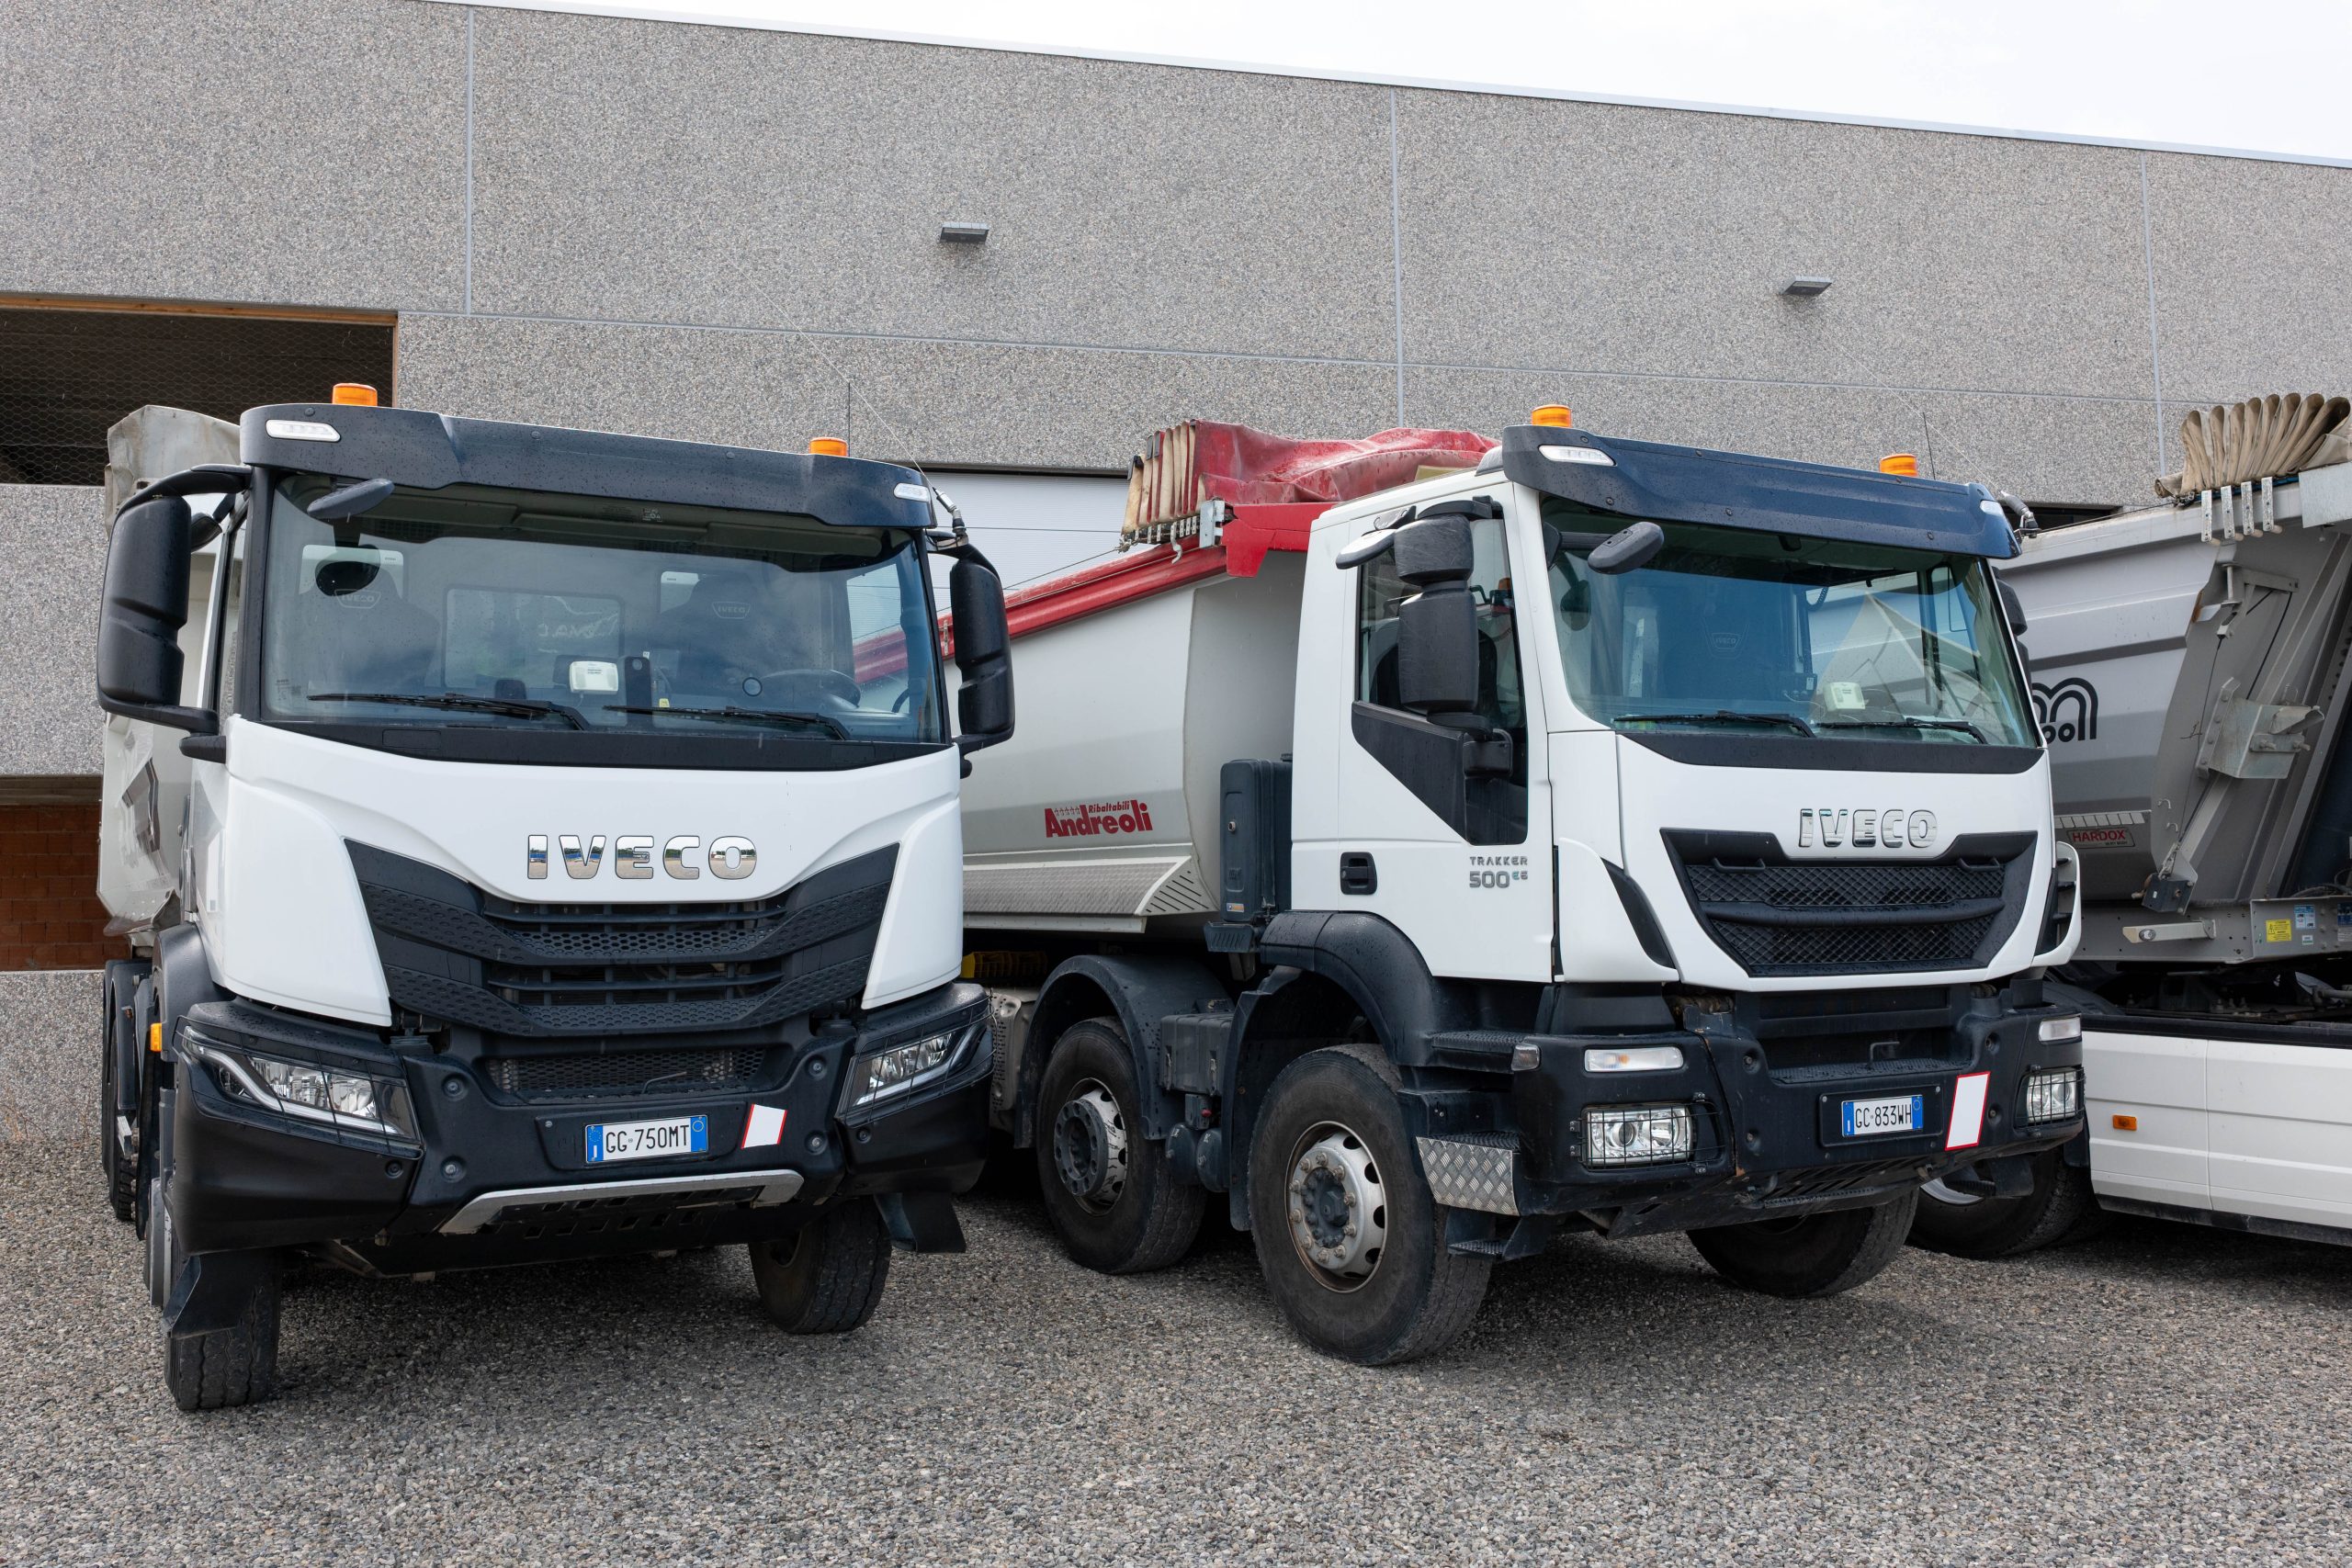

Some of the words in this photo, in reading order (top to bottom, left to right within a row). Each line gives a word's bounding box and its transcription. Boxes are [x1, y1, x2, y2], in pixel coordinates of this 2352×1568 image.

[1044, 799, 1153, 838] Andreoli
[1088, 801, 1130, 814] Ribaltabili
[1798, 808, 1938, 849] IVECO
[2072, 829, 2126, 842] HARDOX
[527, 834, 758, 880] IVECO
[1469, 856, 1528, 866] TRAKKER
[1469, 870, 1510, 889] 500
[1874, 1103, 1912, 1127] 833WH
[634, 1124, 690, 1150] 750MT
